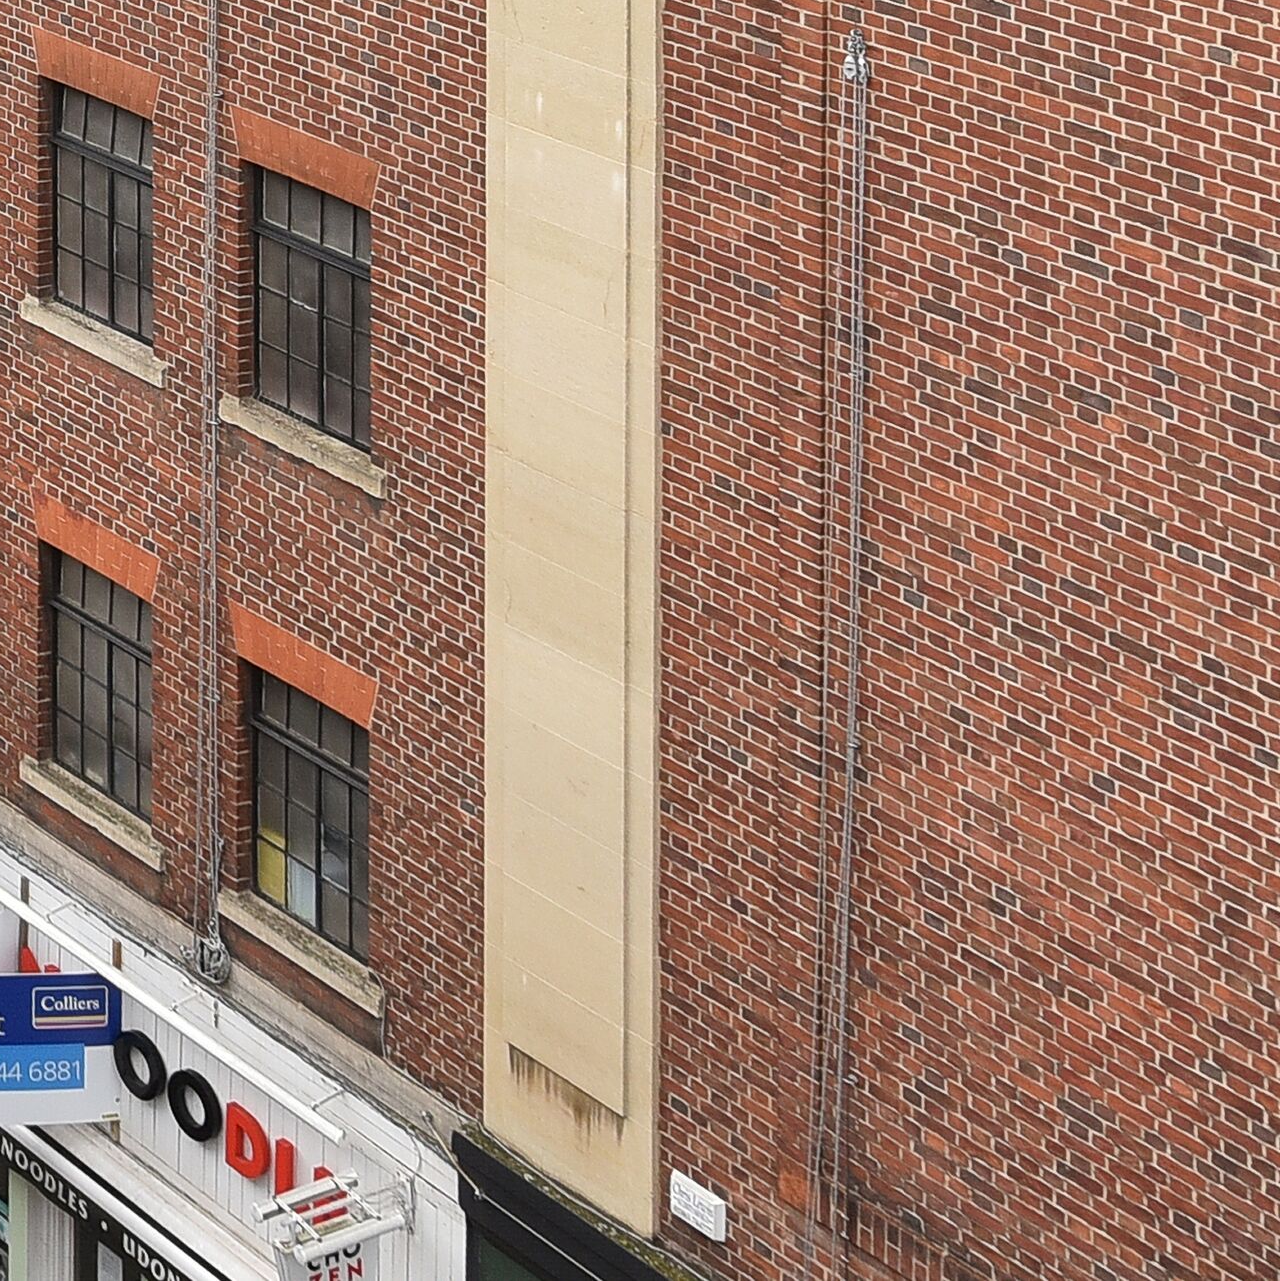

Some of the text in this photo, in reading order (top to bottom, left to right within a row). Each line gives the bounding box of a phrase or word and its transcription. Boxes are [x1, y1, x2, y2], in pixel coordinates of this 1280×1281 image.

[41, 995, 100, 1012] Colliers
[28, 1060, 81, 1082] 6881
[0, 1135, 89, 1220] NOODLES
